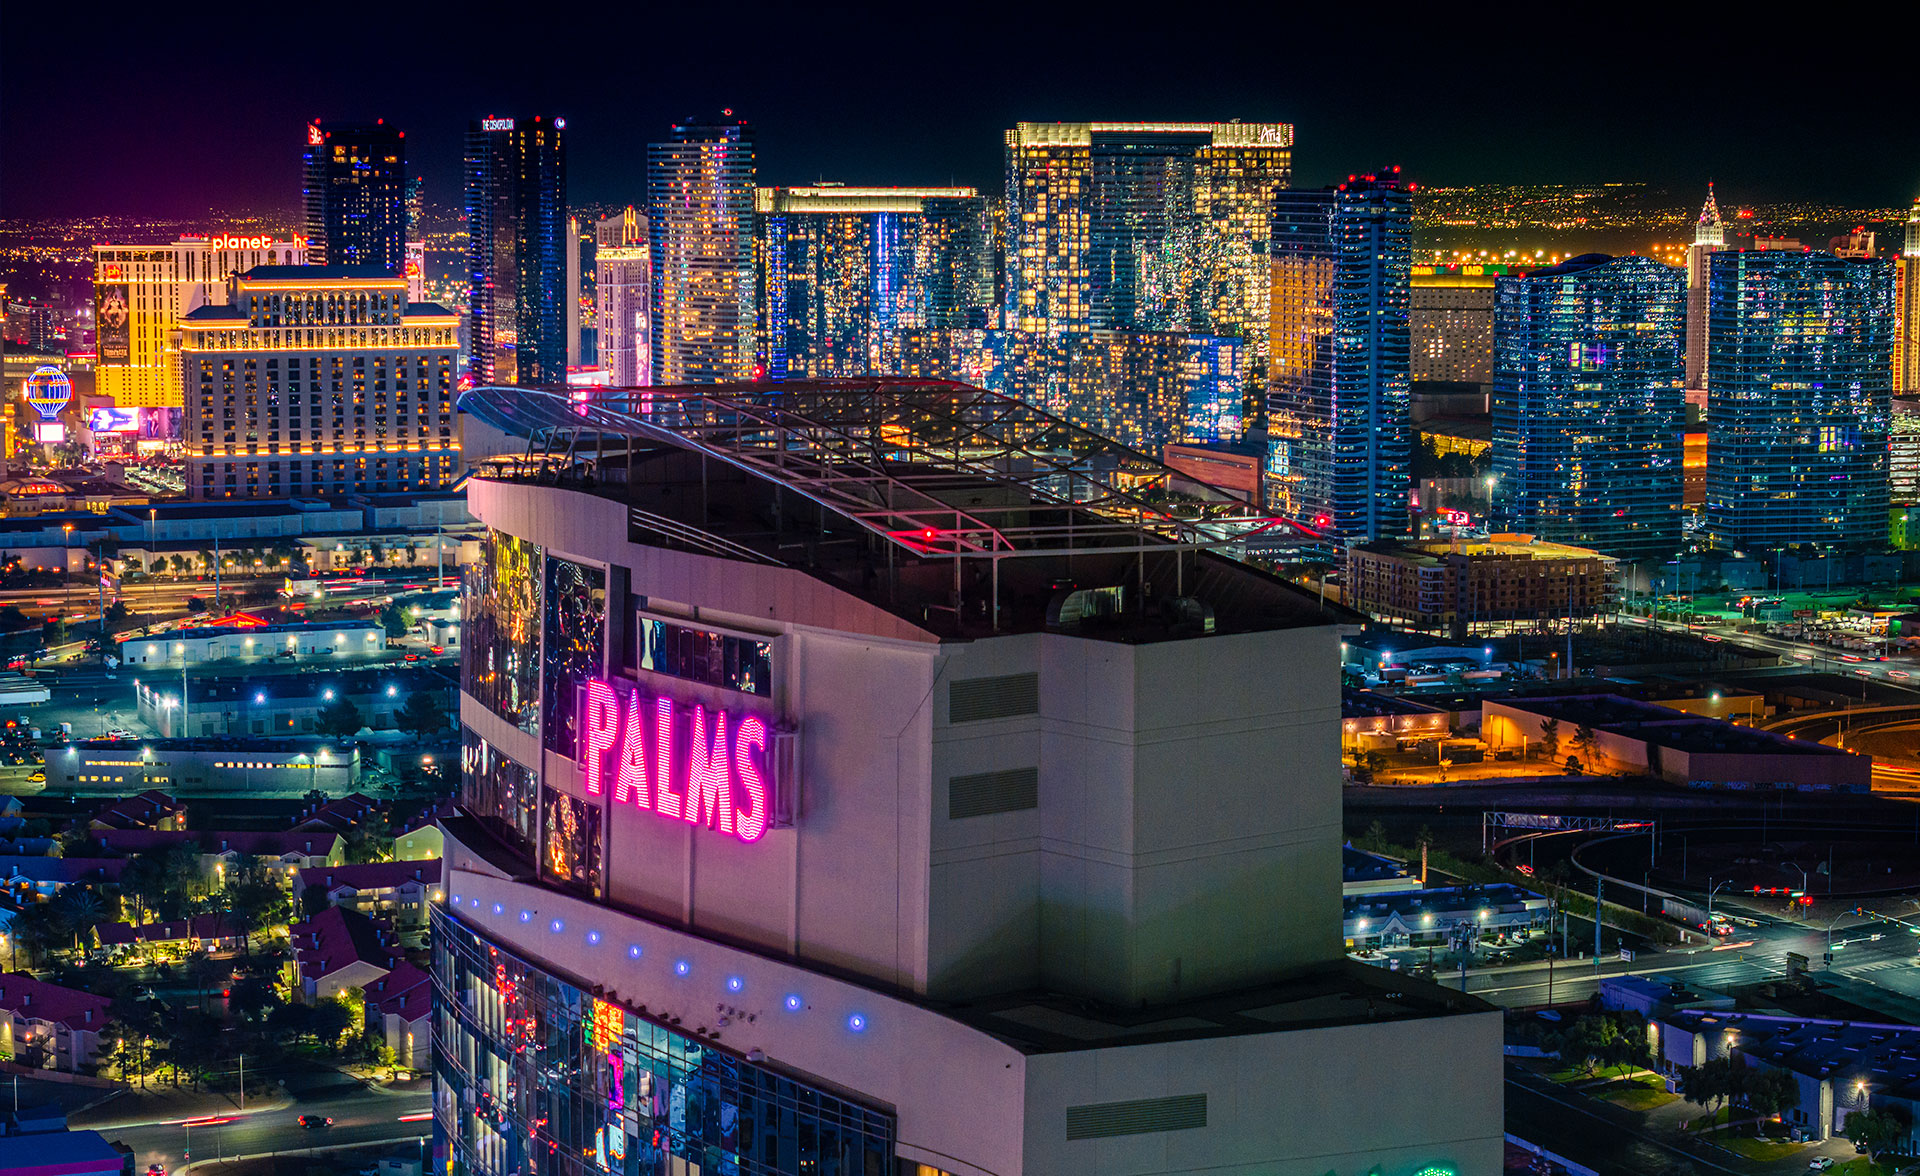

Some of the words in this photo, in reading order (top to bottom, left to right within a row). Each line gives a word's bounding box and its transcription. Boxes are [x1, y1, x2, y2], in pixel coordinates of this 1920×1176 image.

[1260, 125, 1282, 144] Aria
[212, 232, 272, 253] planet
[586, 680, 767, 843] PALMS
